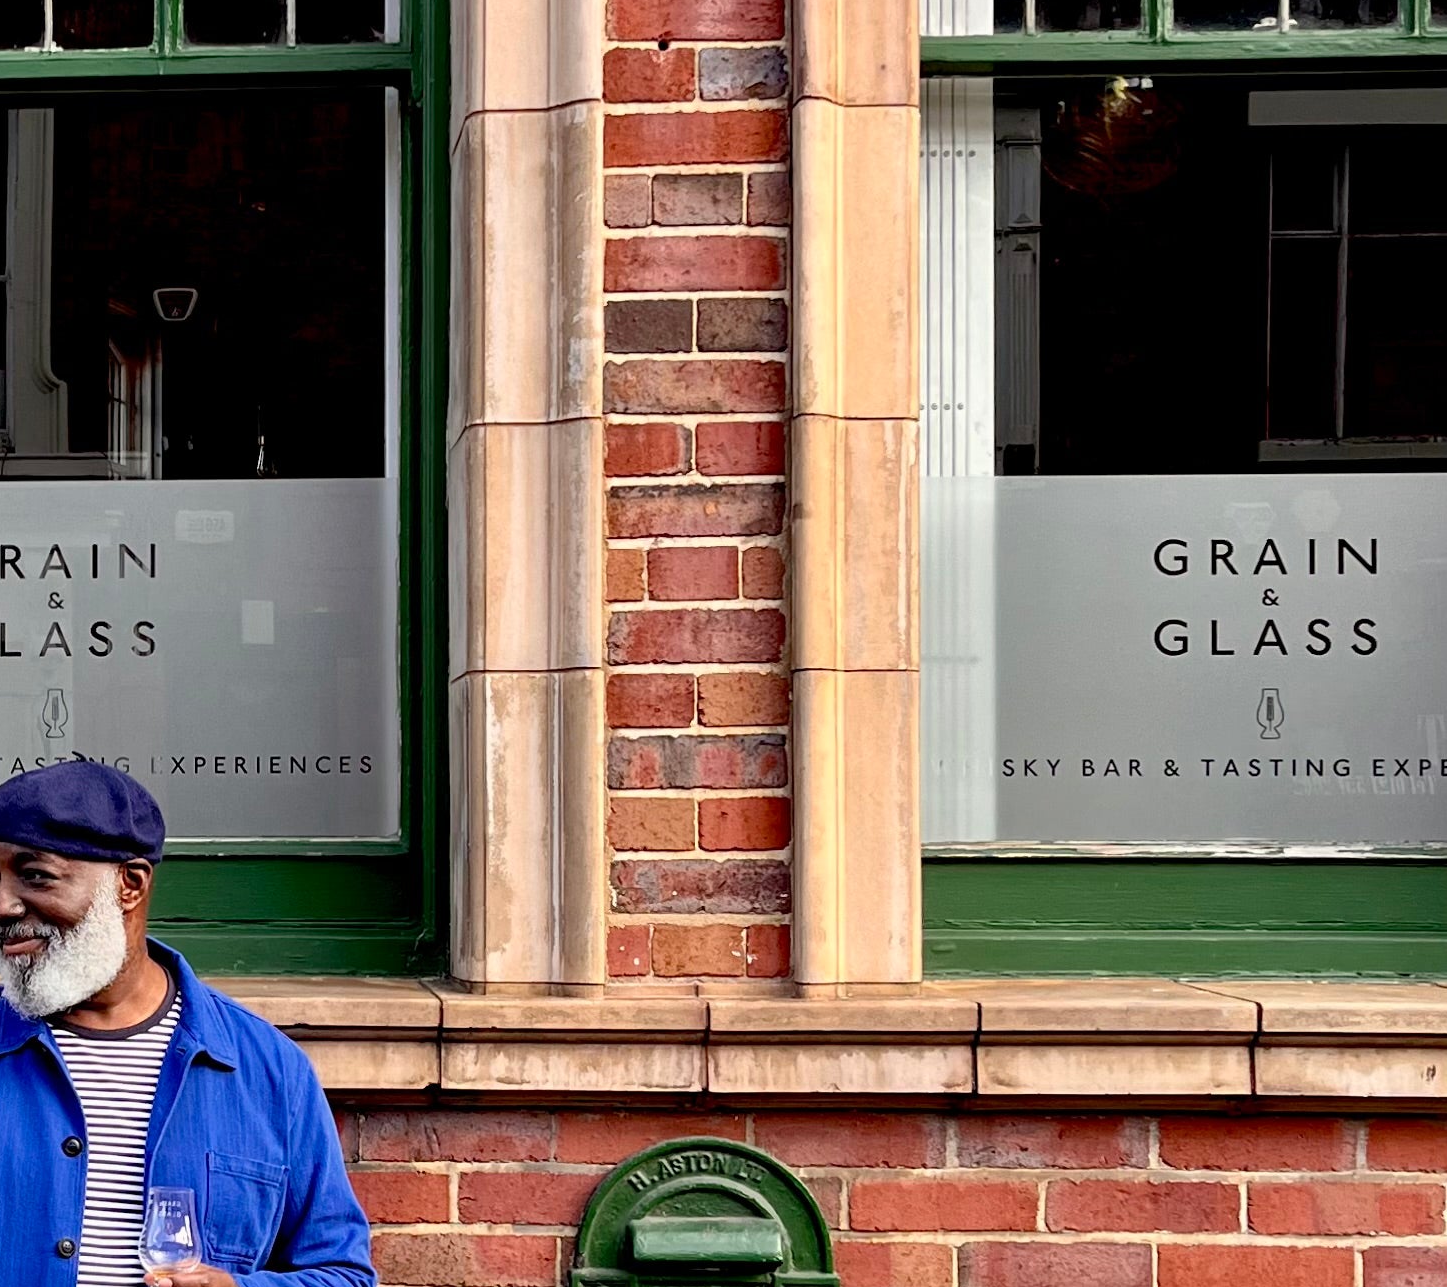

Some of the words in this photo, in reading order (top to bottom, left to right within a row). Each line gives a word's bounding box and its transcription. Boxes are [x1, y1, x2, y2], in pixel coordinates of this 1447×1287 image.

[1154, 538, 1378, 576] GRAIN
[48, 592, 64, 610] &
[1261, 588, 1280, 607] &
[1154, 618, 1378, 656] GLASS
[1082, 759, 1144, 778] BAR
[1164, 759, 1181, 778] &
[1200, 759, 1351, 778] TASTING
